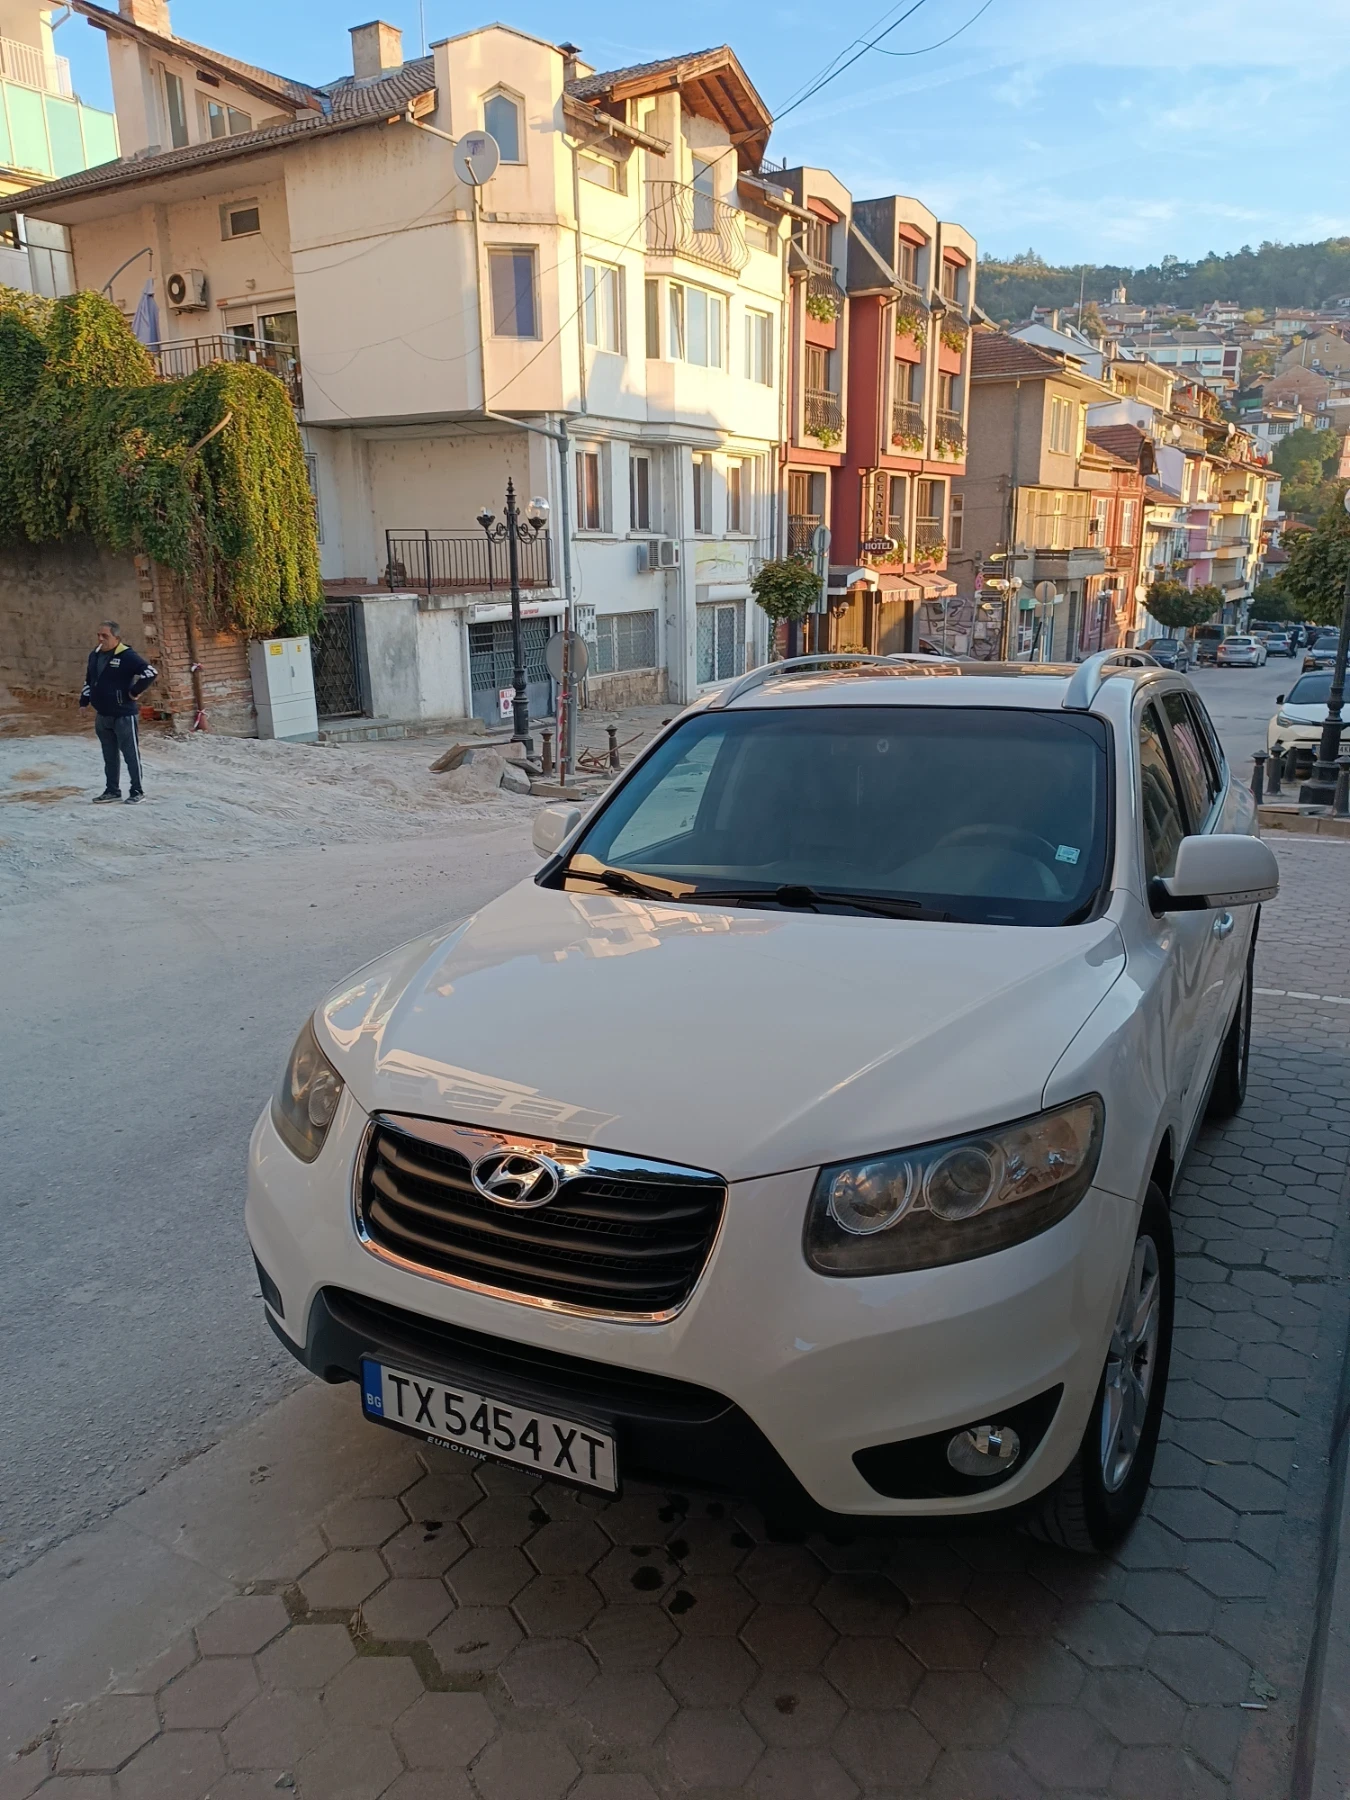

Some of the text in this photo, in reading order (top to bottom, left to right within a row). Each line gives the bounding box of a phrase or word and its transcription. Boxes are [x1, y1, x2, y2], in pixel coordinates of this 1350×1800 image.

[875, 475, 886, 535] CENTRAL
[864, 541, 893, 551] HOTEL
[366, 1392, 382, 1409] BG
[427, 1436, 488, 1461] EUROLINK
